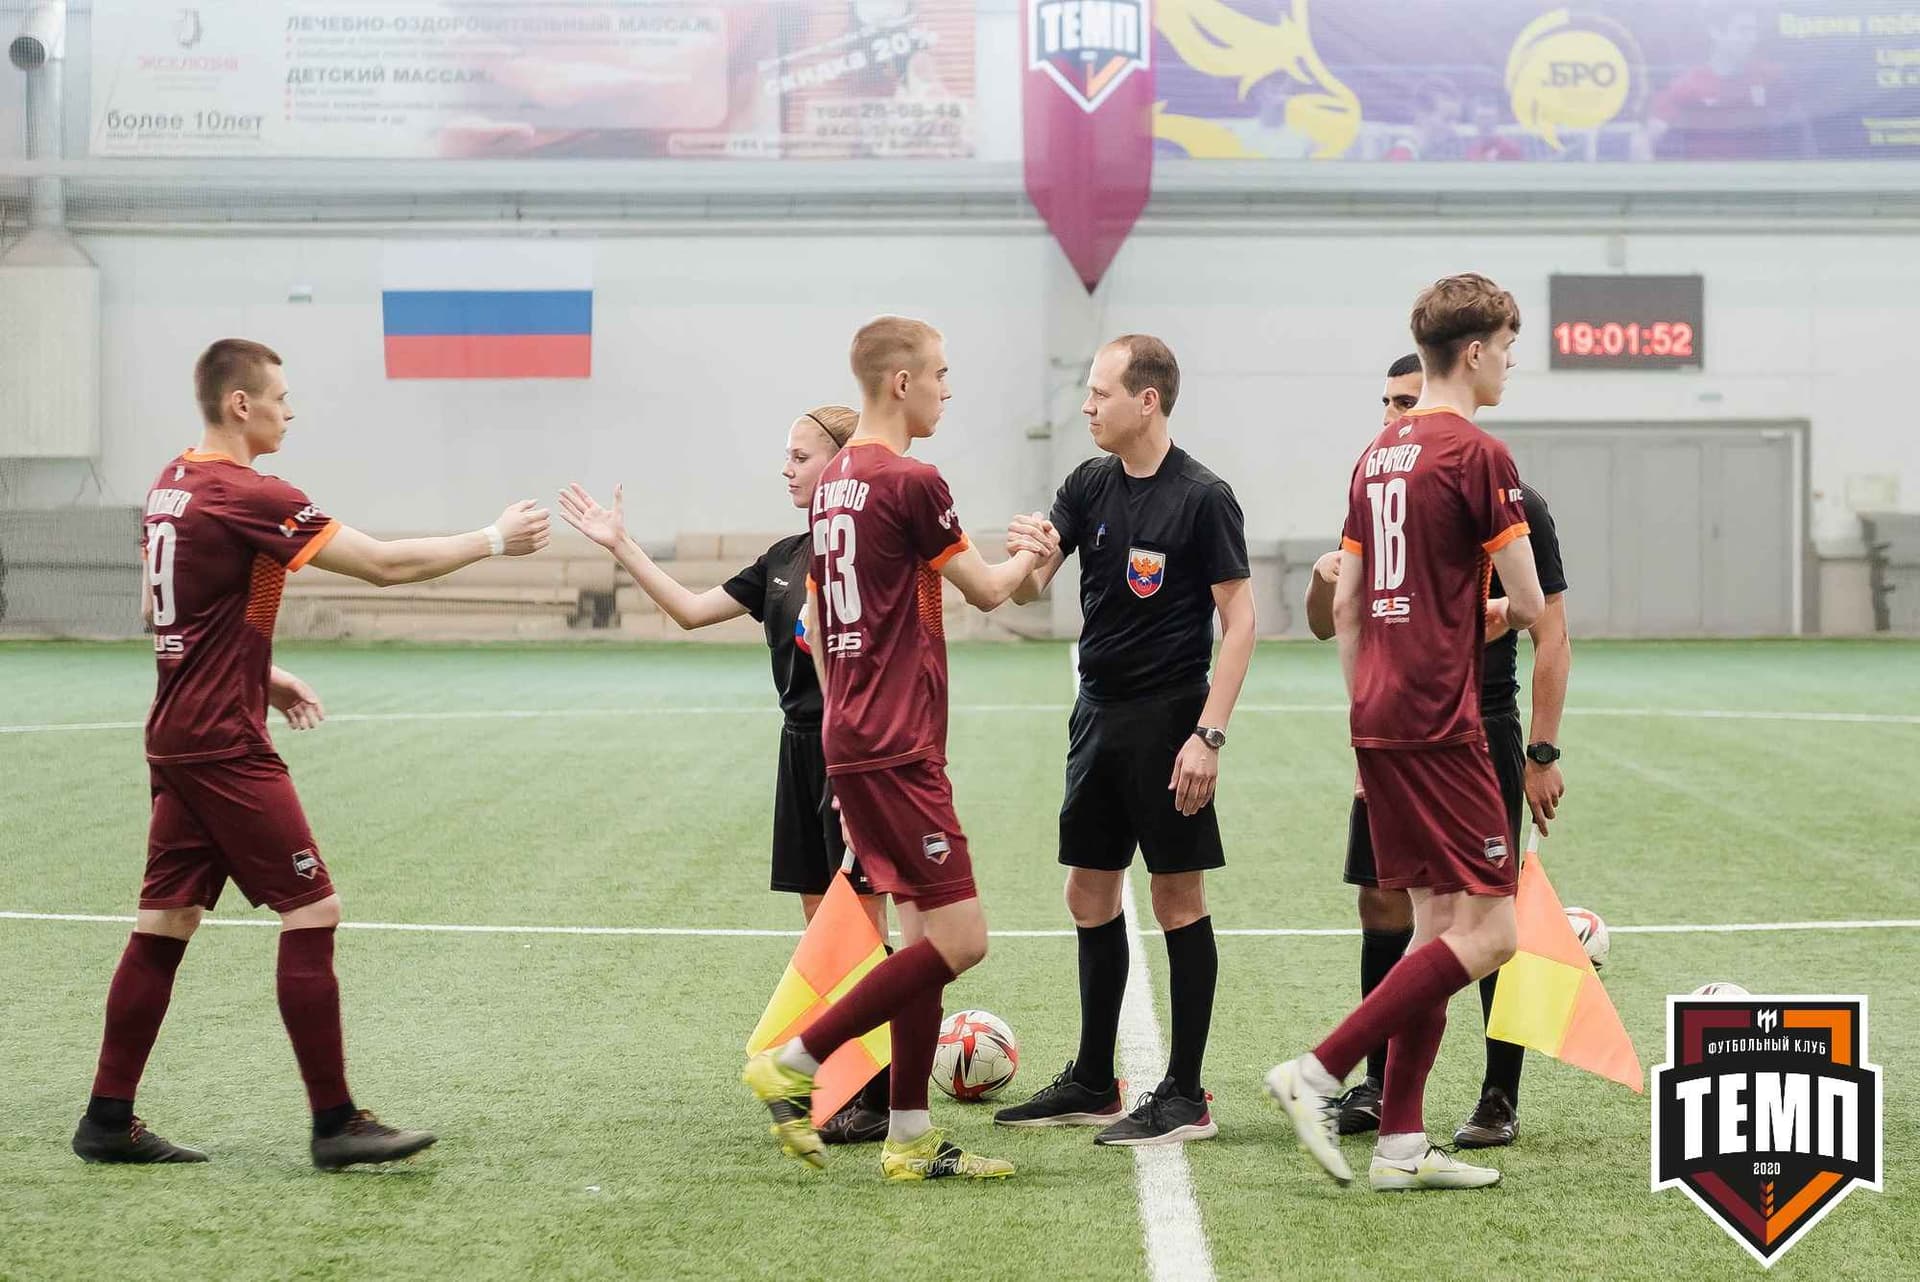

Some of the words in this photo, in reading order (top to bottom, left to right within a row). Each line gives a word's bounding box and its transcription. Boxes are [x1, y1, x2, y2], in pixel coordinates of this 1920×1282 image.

[1040, 1, 1139, 53] ТЕМП
[286, 65, 385, 84] ДЕТСКИЙ
[1553, 321, 1694, 356] 19:01:52
[1366, 477, 1408, 591] 18
